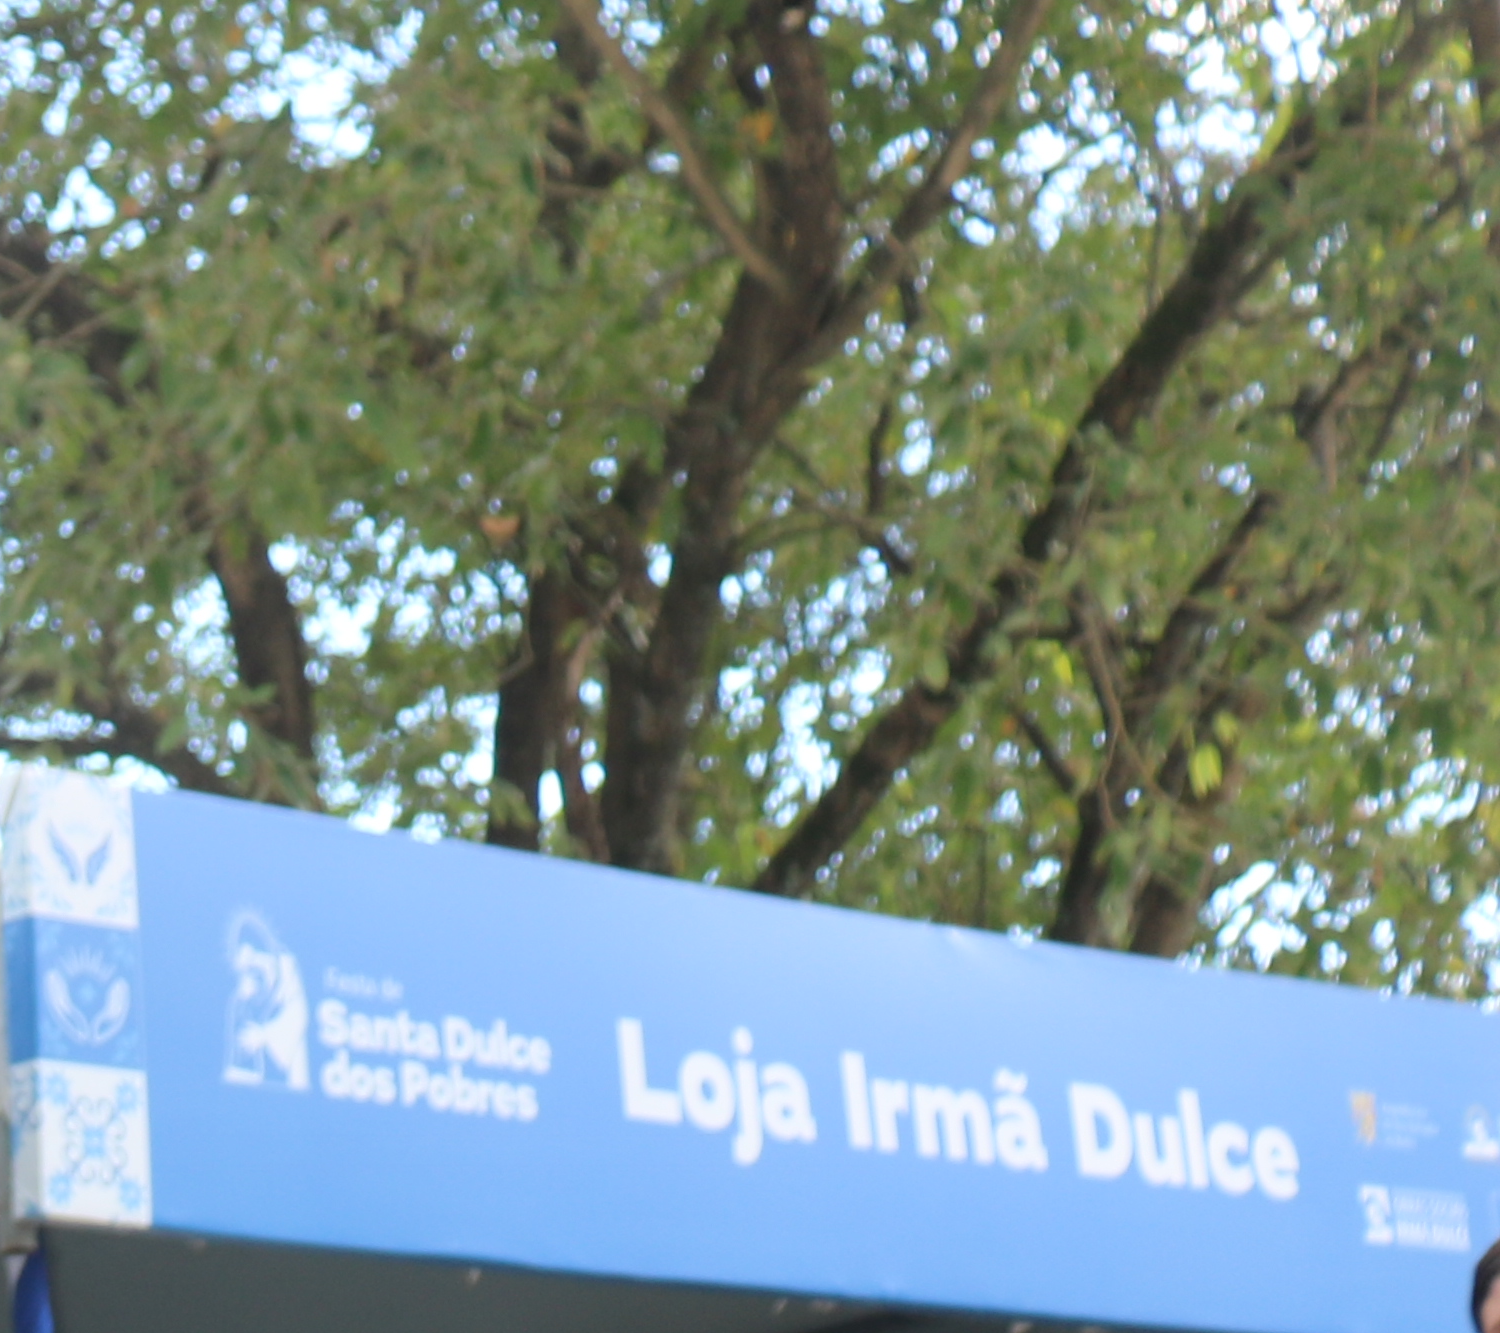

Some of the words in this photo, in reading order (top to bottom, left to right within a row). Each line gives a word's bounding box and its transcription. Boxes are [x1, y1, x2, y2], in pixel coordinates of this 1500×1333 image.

[317, 998, 442, 1060] Santa
[442, 1014, 552, 1076] Dulce
[321, 1047, 398, 1106] dos
[399, 1059, 540, 1123] Pobres
[615, 1016, 817, 1168] Loja
[840, 1049, 1048, 1174] Irmã
[1068, 1081, 1301, 1200] Dulce
